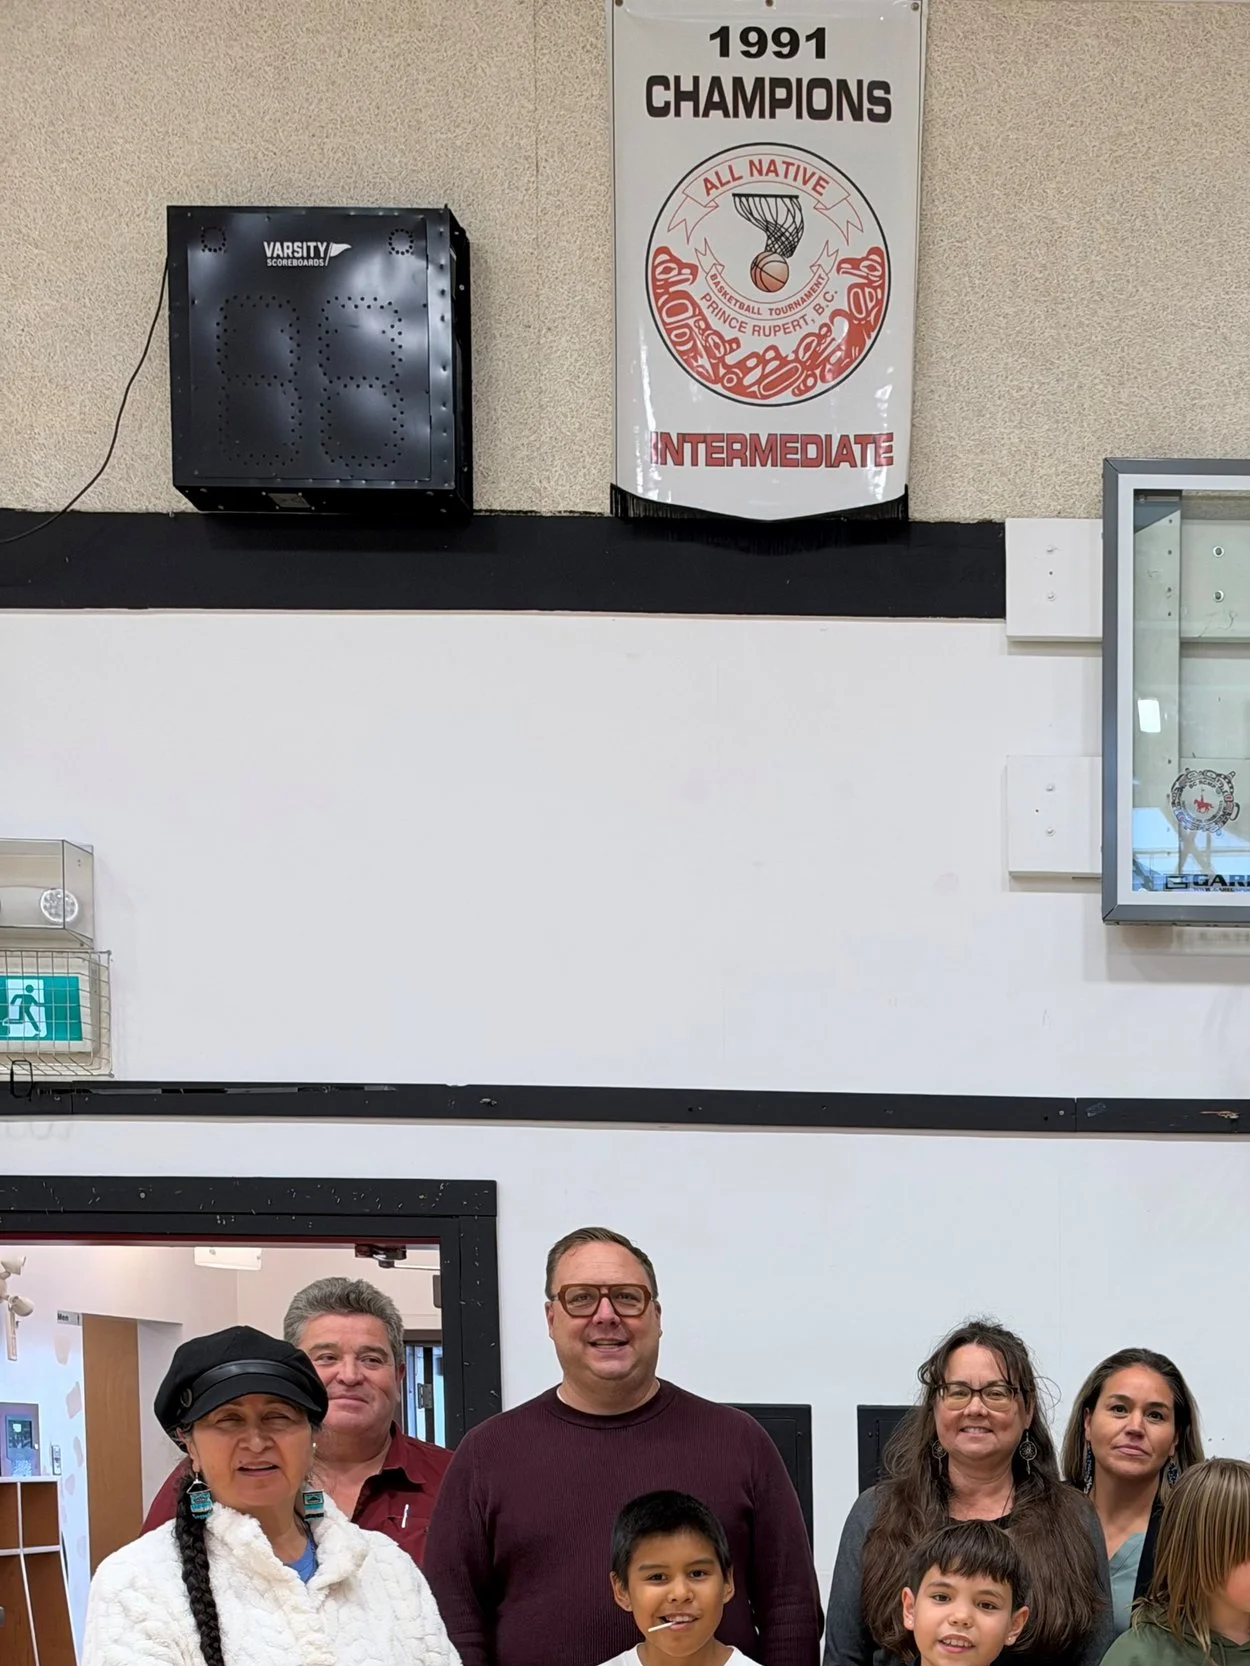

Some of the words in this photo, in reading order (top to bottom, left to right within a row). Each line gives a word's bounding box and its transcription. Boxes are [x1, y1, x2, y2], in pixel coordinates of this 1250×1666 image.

[709, 25, 827, 59] 1991
[645, 75, 892, 123] CHAMPIONS
[702, 164, 743, 197] ALL
[748, 158, 830, 197] NATIVE
[263, 241, 328, 258] VARSITY
[266, 258, 325, 267] SCOREBOARDS
[700, 292, 749, 334] PRINCE
[751, 313, 816, 338] RUPERT,
[812, 289, 838, 316] B.C.
[709, 273, 763, 316] BASKETBALL
[768, 274, 826, 316] TOURNAMENT
[650, 430, 894, 468] INTERMEDIATE
